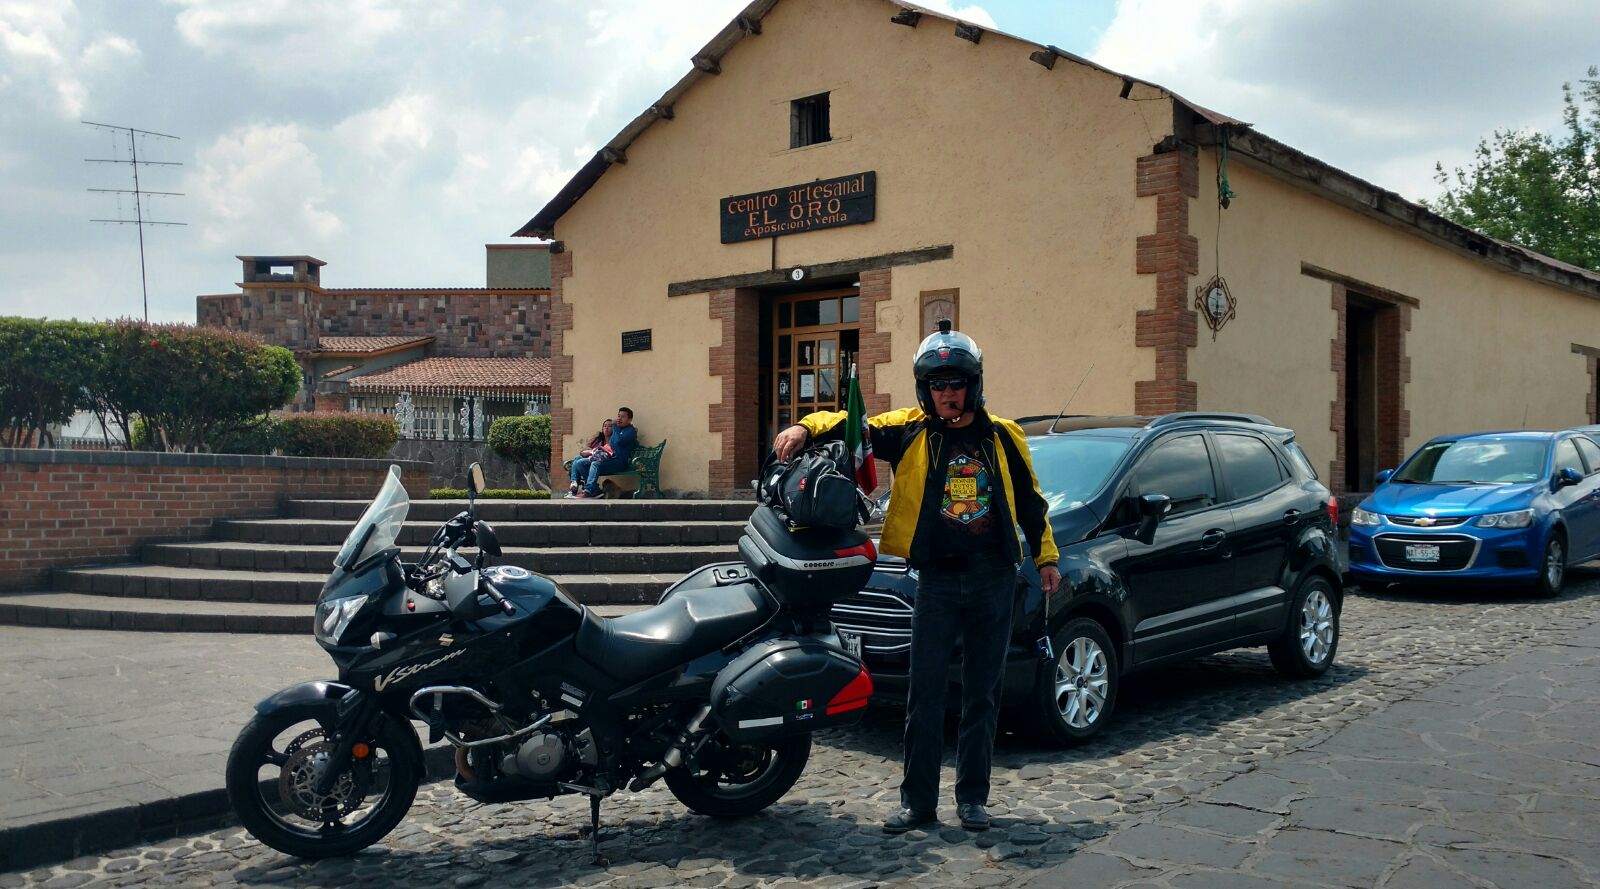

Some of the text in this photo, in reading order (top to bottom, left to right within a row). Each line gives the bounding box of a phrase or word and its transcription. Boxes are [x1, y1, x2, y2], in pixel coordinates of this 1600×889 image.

[728, 174, 865, 215] centro artesanal
[749, 198, 841, 227] EL ORO
[815, 212, 848, 225] venta
